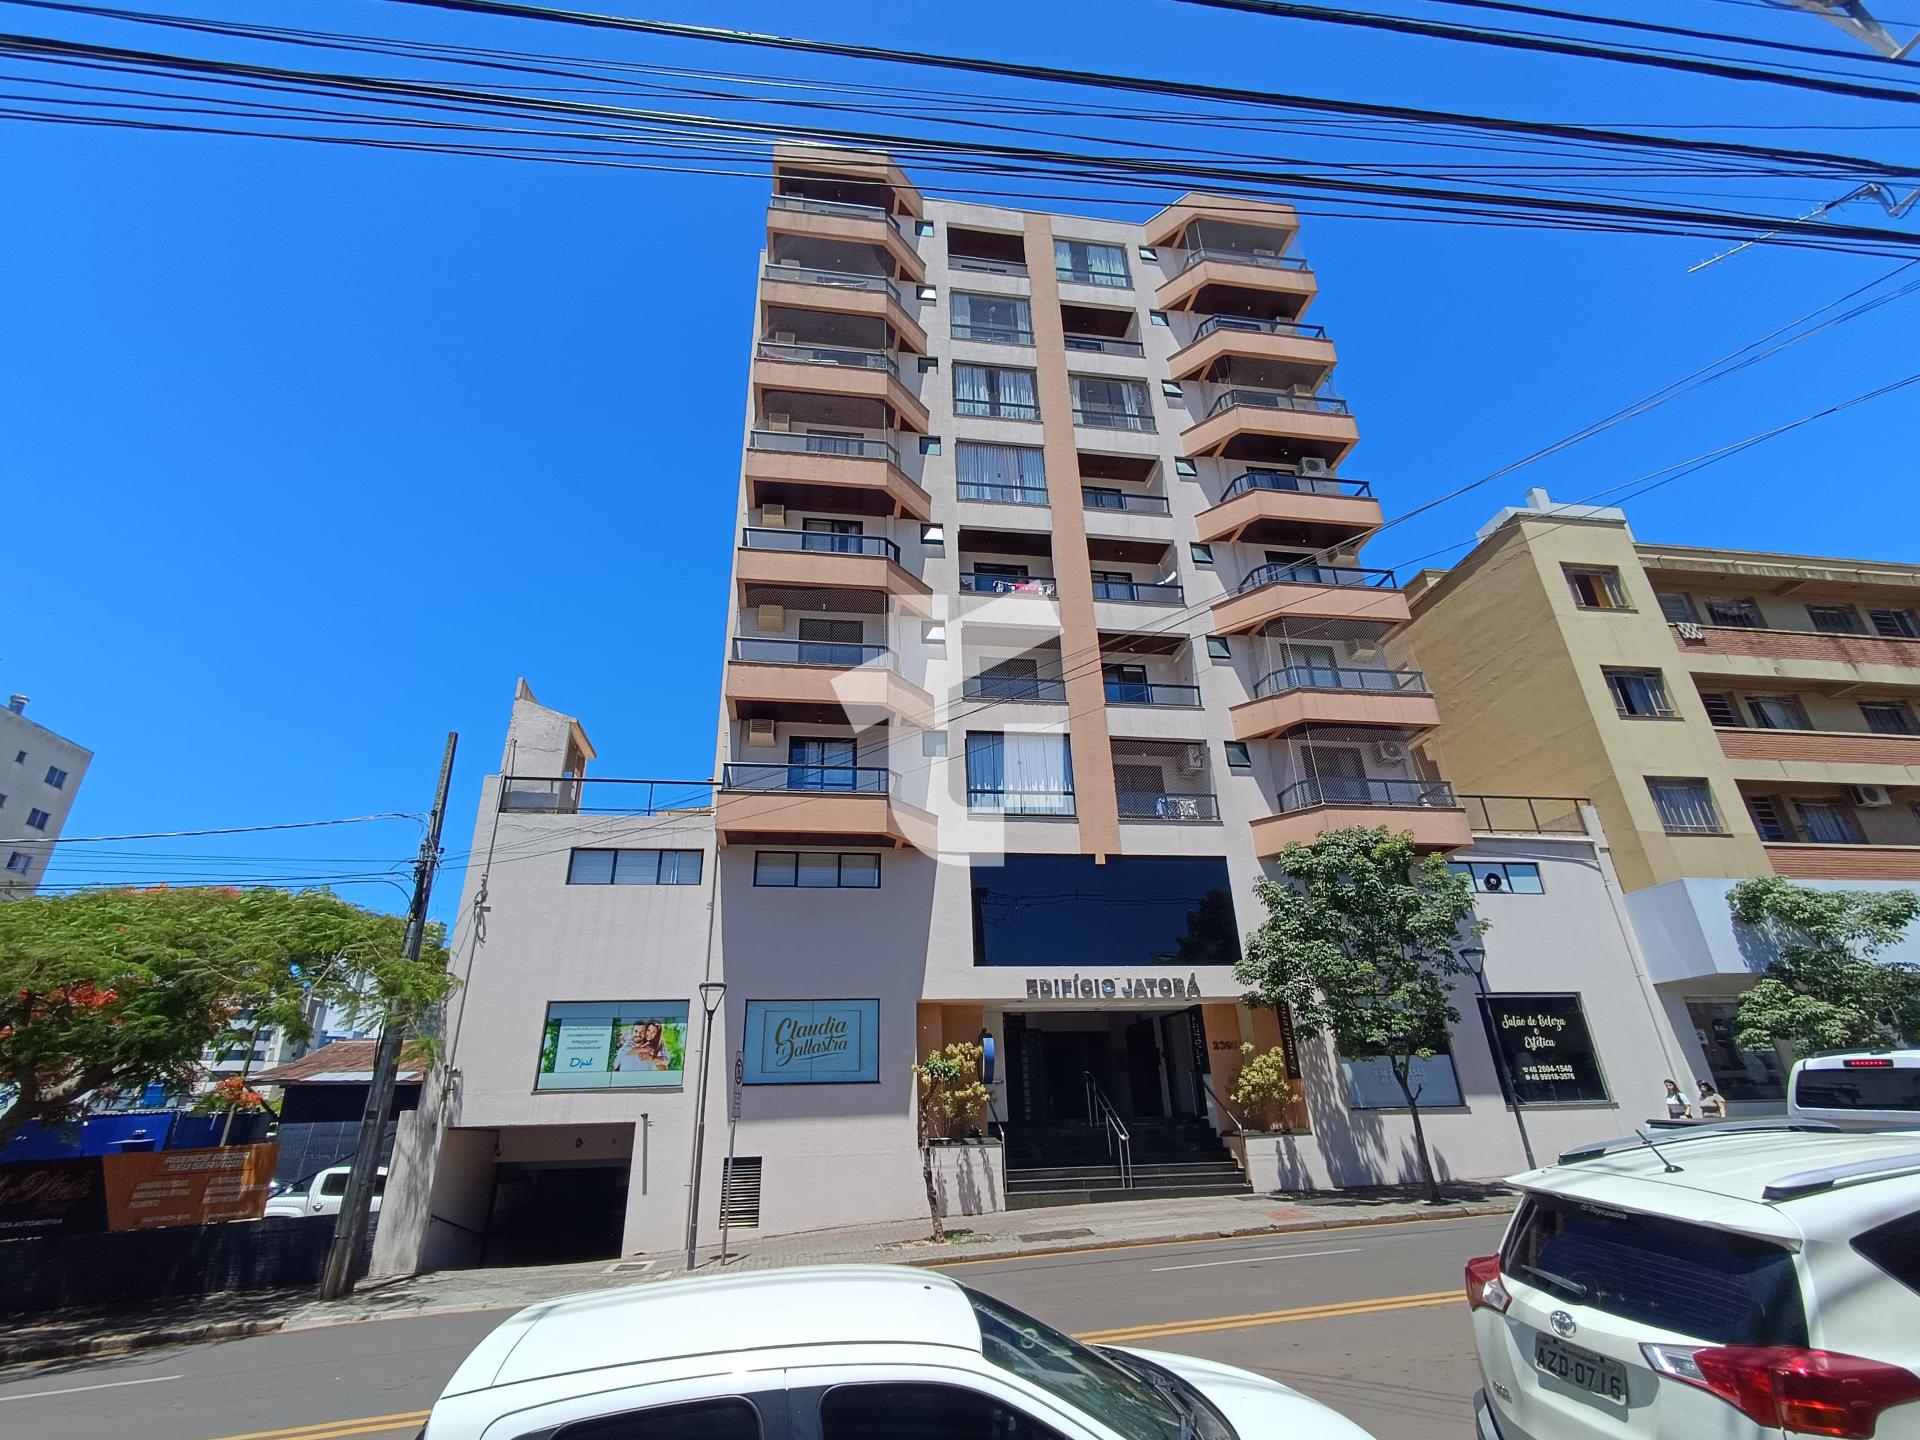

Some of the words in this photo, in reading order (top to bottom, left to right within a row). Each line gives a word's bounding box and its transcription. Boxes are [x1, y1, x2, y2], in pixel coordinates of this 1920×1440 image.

[1026, 973, 1115, 998] EDIFÍCIO
[1122, 972, 1201, 998] JATOBÁ
[775, 1016, 848, 1045] Claudia
[1502, 1014, 1525, 1029] Salão
[1527, 1015, 1537, 1026] de
[1538, 1014, 1566, 1032] Beleza
[1524, 1036, 1555, 1051] Estética
[1536, 1347, 1621, 1401] AZD-0716
